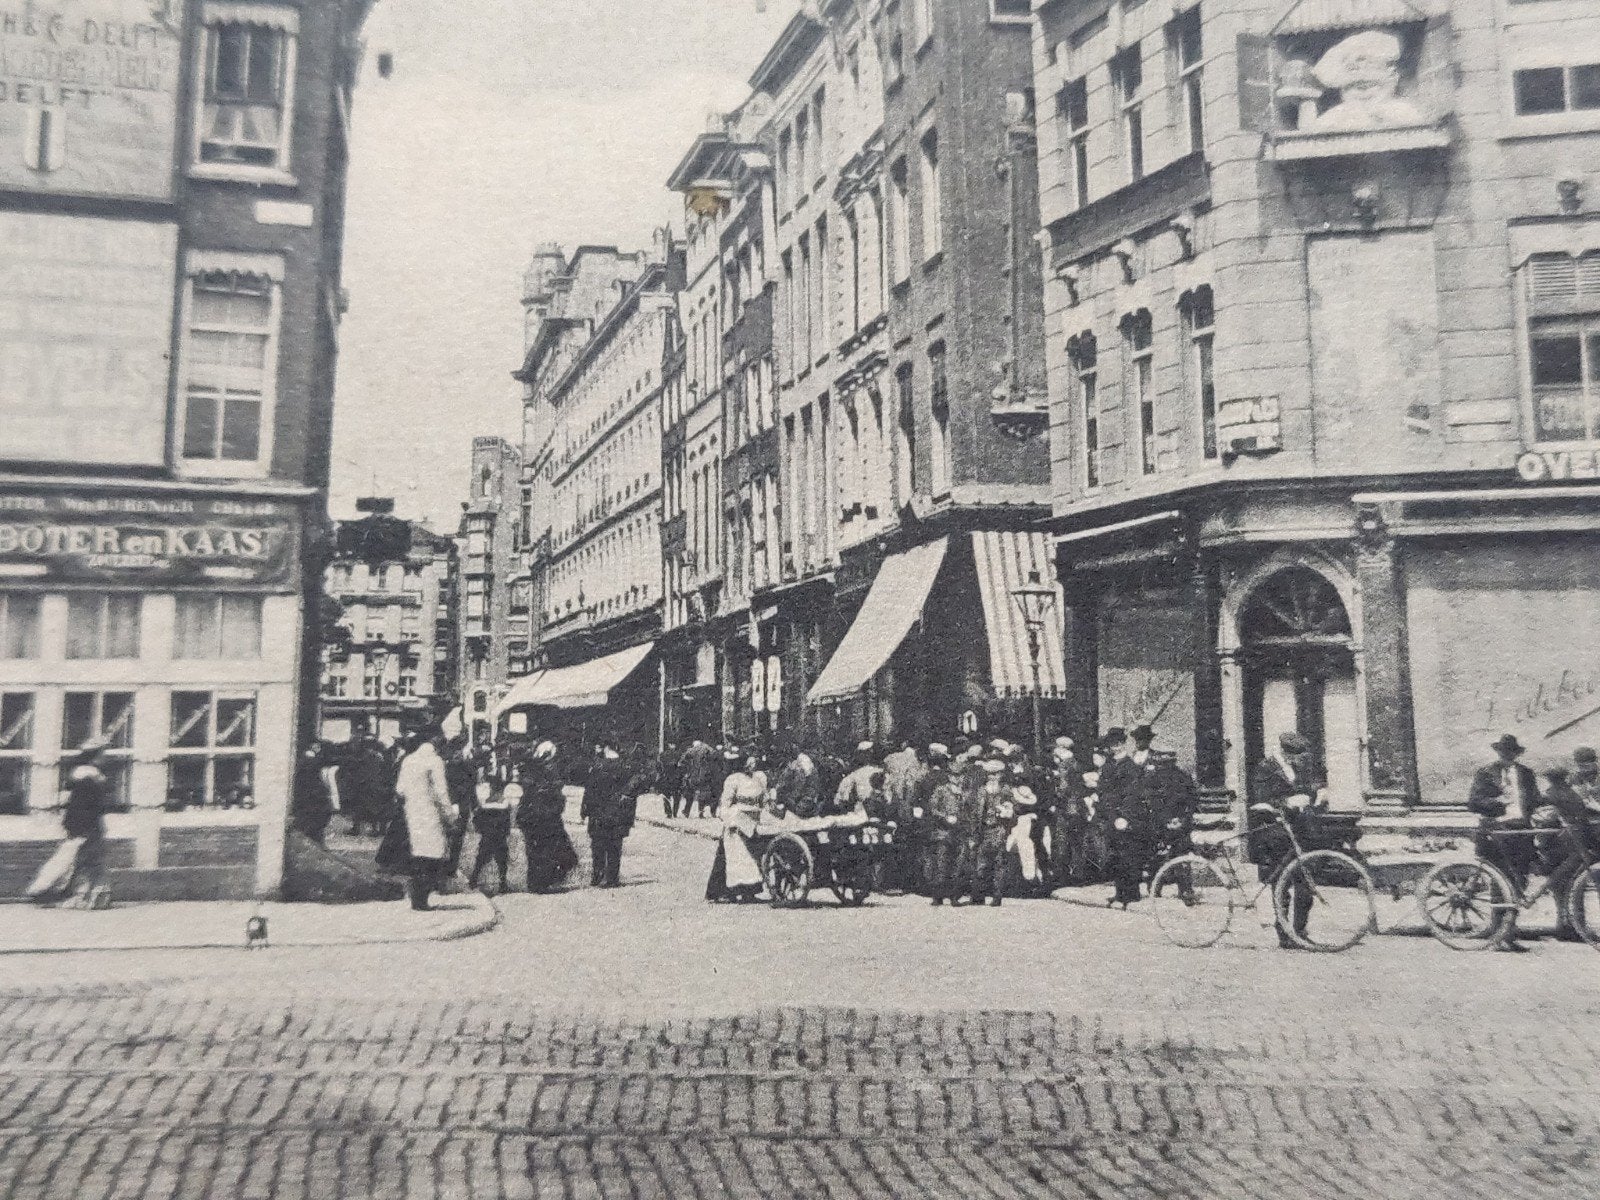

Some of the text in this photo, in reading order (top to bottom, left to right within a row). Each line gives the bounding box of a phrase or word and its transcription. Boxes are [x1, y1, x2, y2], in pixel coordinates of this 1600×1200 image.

[1518, 451, 1600, 481] OVE
[0, 524, 263, 557] BOTER en KAAS
